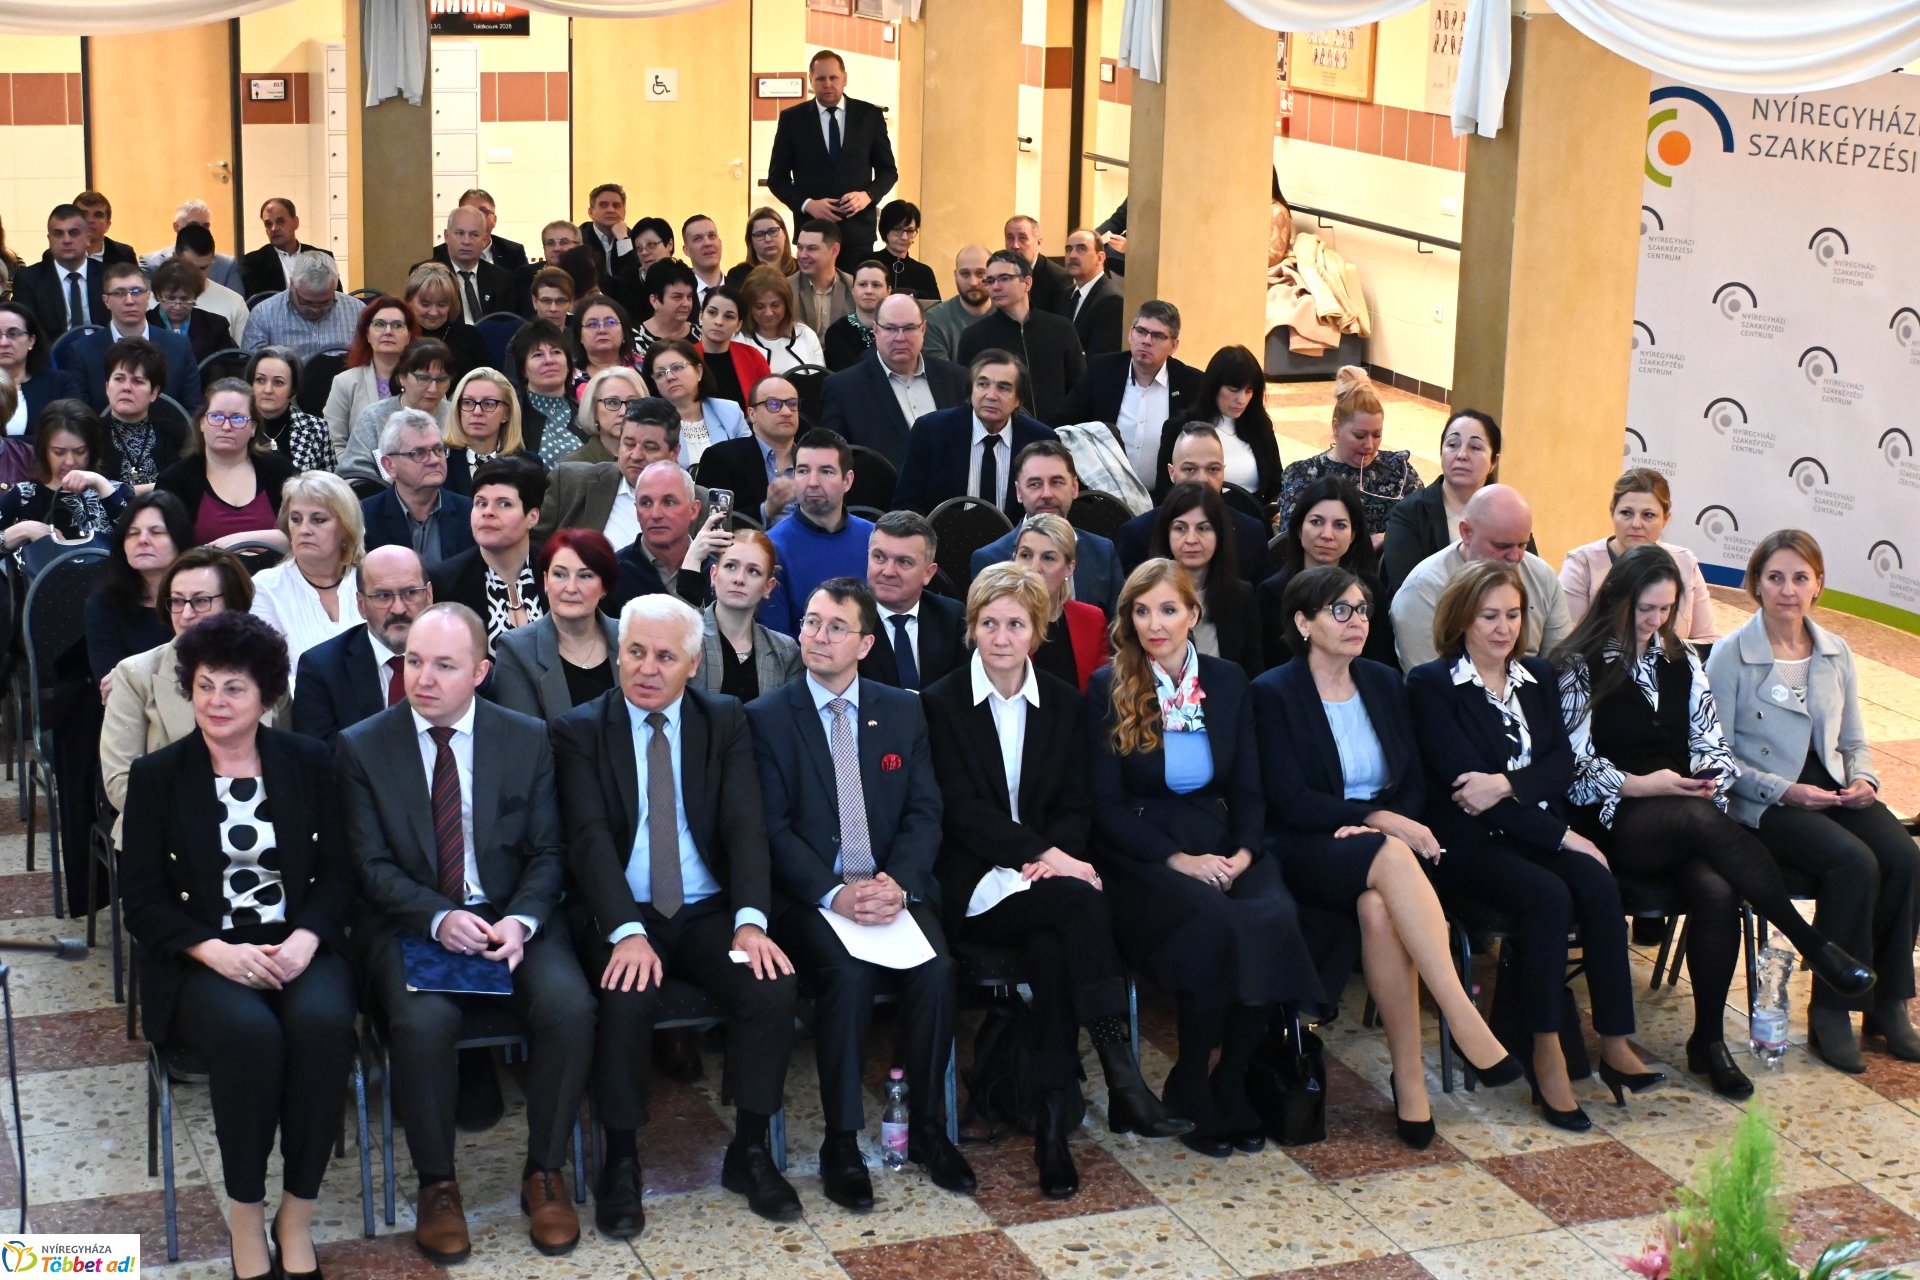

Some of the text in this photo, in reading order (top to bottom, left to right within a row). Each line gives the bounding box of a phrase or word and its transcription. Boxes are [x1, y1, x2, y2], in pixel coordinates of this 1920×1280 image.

[1748, 134, 1917, 174] SZAKKÉPZÉSI
[1648, 236, 1694, 246] NYÍREGYHÁZI
[1647, 244, 1693, 254] SZAKKÉPZÉSI
[1647, 253, 1681, 261] CENTRUM
[1740, 330, 1774, 340] CENTRUM
[1639, 350, 1685, 361] NYÍREGYHÁZI
[1638, 358, 1684, 369] SZAKKÉPZÉSI
[1638, 366, 1672, 376] CENTRUM
[1723, 552, 1749, 561] CENTRU
